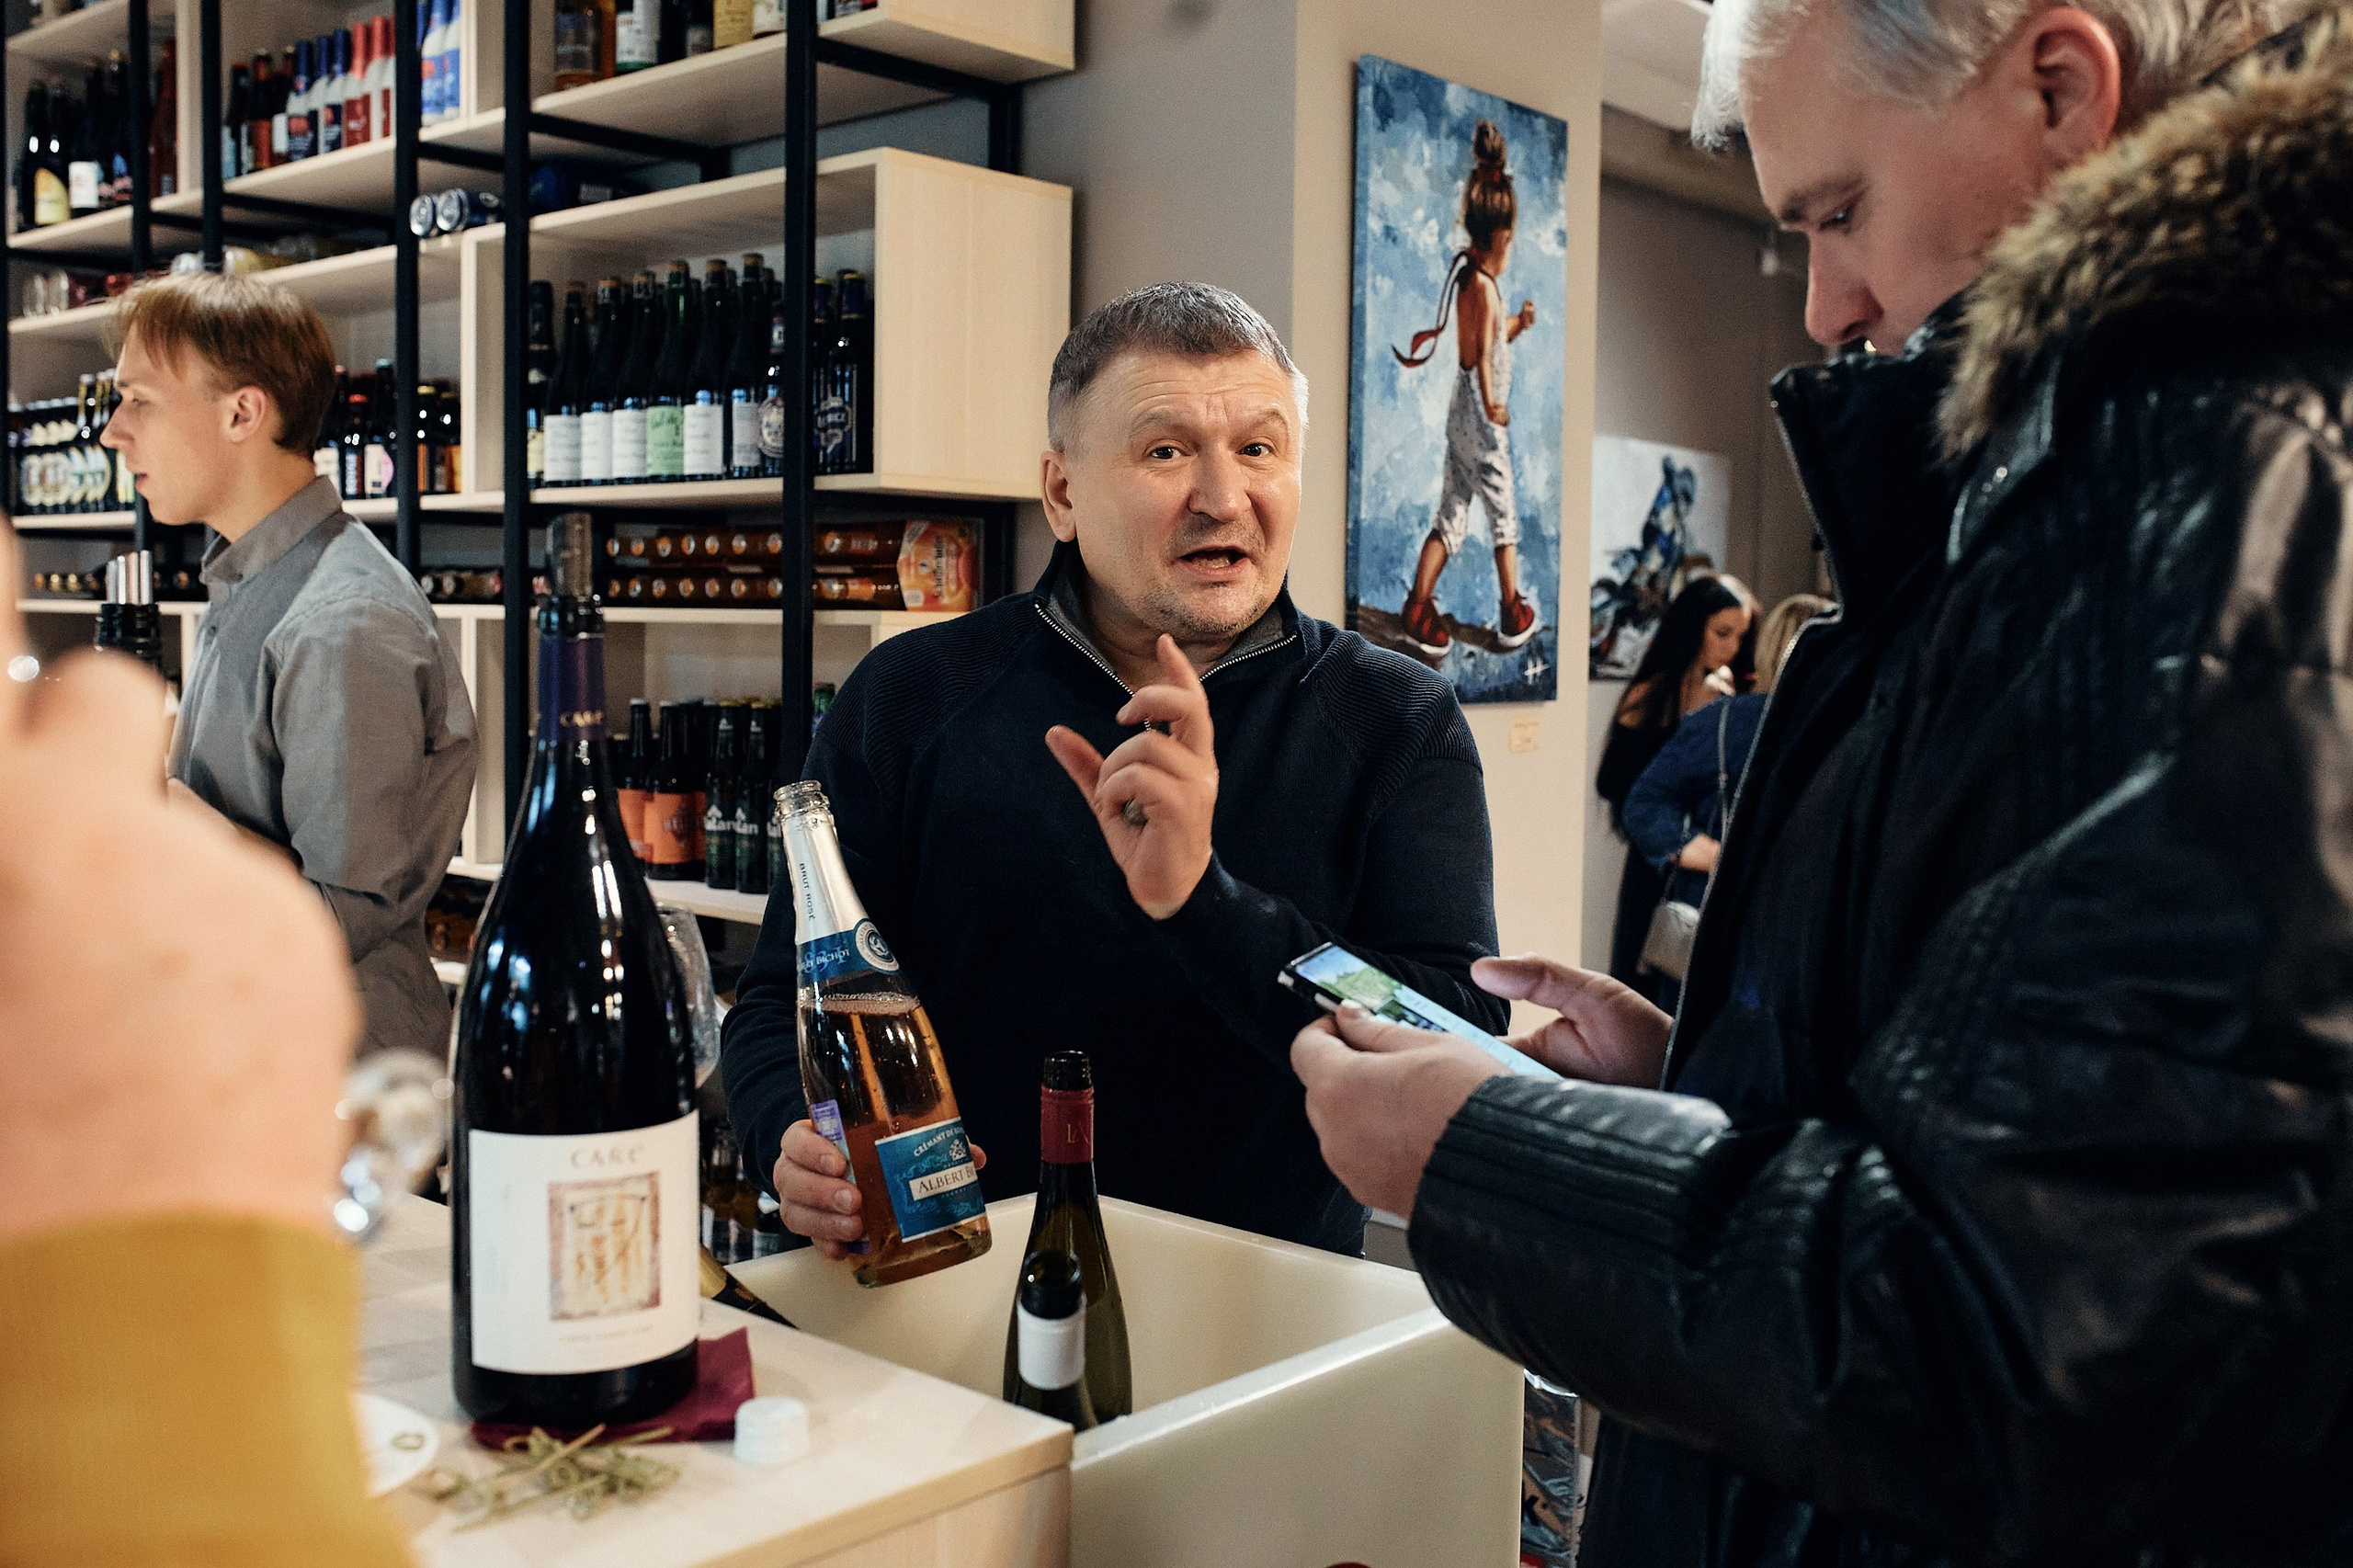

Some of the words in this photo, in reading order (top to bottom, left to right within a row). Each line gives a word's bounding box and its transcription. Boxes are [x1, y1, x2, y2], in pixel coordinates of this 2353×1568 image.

[799, 862, 810, 889] BRUT
[816, 949, 850, 965] BICHOT
[919, 1170, 964, 1194] ALBERT
